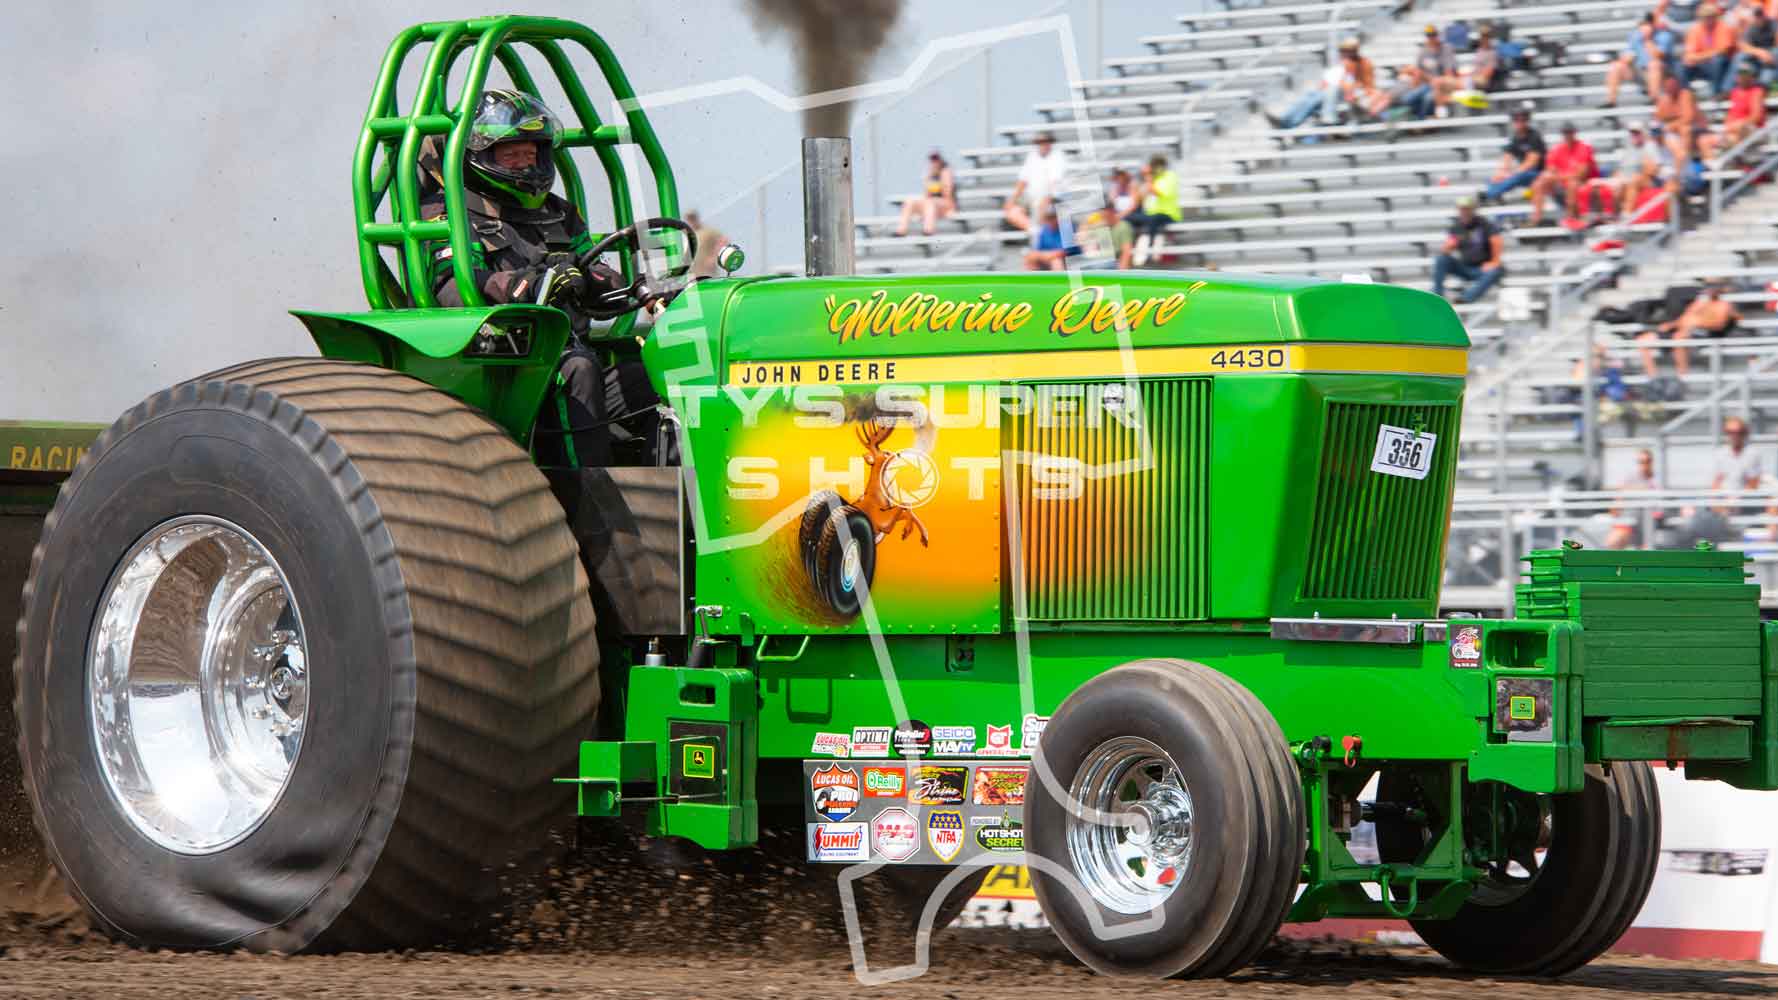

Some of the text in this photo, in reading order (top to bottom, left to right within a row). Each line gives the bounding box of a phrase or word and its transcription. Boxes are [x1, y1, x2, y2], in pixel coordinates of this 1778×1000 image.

[1211, 350, 1284, 368] 4430
[742, 362, 896, 384] JOHN DEERE
[1387, 438, 1423, 468] 356
[855, 729, 888, 744] OPTIMA
[816, 775, 853, 785] LUCAS OIL
[867, 770, 901, 790] O'Reilly
[936, 830, 957, 844] NTPA
